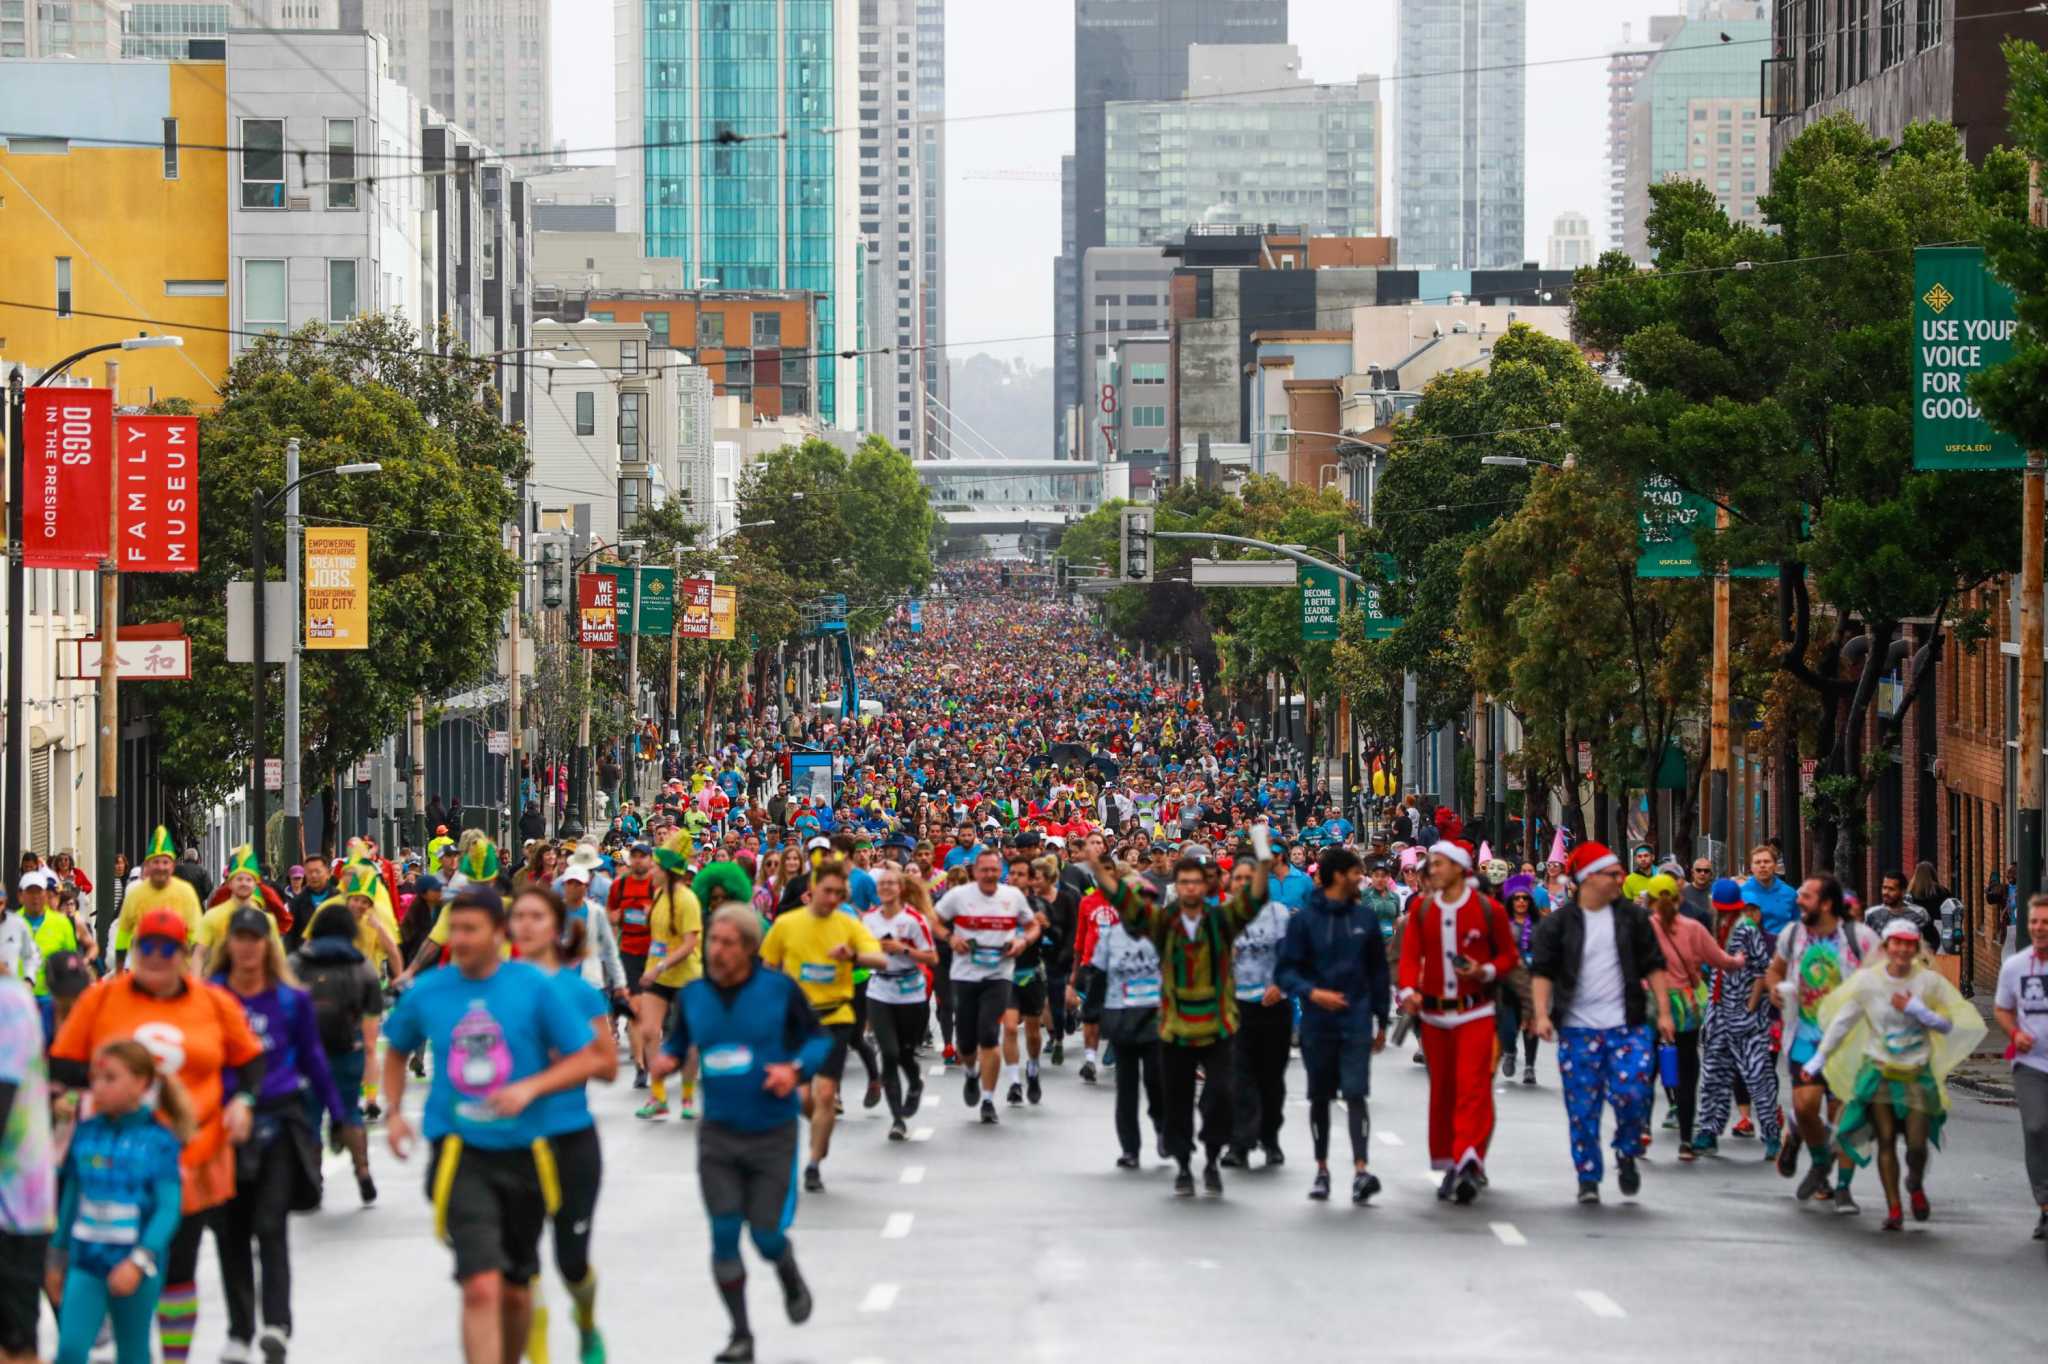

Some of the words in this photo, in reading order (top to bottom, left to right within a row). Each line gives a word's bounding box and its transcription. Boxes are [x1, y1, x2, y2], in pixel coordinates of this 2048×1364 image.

[1923, 320, 1959, 341] USE
[1964, 320, 2017, 341] YOUR
[1922, 346, 1981, 367] VOICE
[1922, 372, 1961, 393] FOR
[46, 406, 57, 422] IN
[62, 407, 92, 465] DOGS
[46, 429, 57, 459] THE
[1945, 444, 1992, 452] USFCA.EDU
[128, 426, 147, 561] FAMILY
[167, 426, 186, 561] MUSEUM
[44, 465, 57, 538] PRESIDIO
[308, 539, 355, 548] EMPOWERING
[309, 556, 356, 569] CREATING
[309, 568, 355, 588] JOBS.
[598, 581, 613, 593] WE
[698, 585, 709, 595] WE
[1304, 589, 1332, 597] BECOME
[309, 598, 329, 610] OUR
[332, 598, 356, 610] CITY.
[594, 594, 613, 607] ARE
[694, 595, 708, 605] ARE
[1304, 598, 1310, 606] A
[1311, 598, 1336, 606] BETTER
[1304, 607, 1330, 615] LEADER
[683, 624, 708, 633] SFMADE
[582, 632, 614, 642] SFMADE
